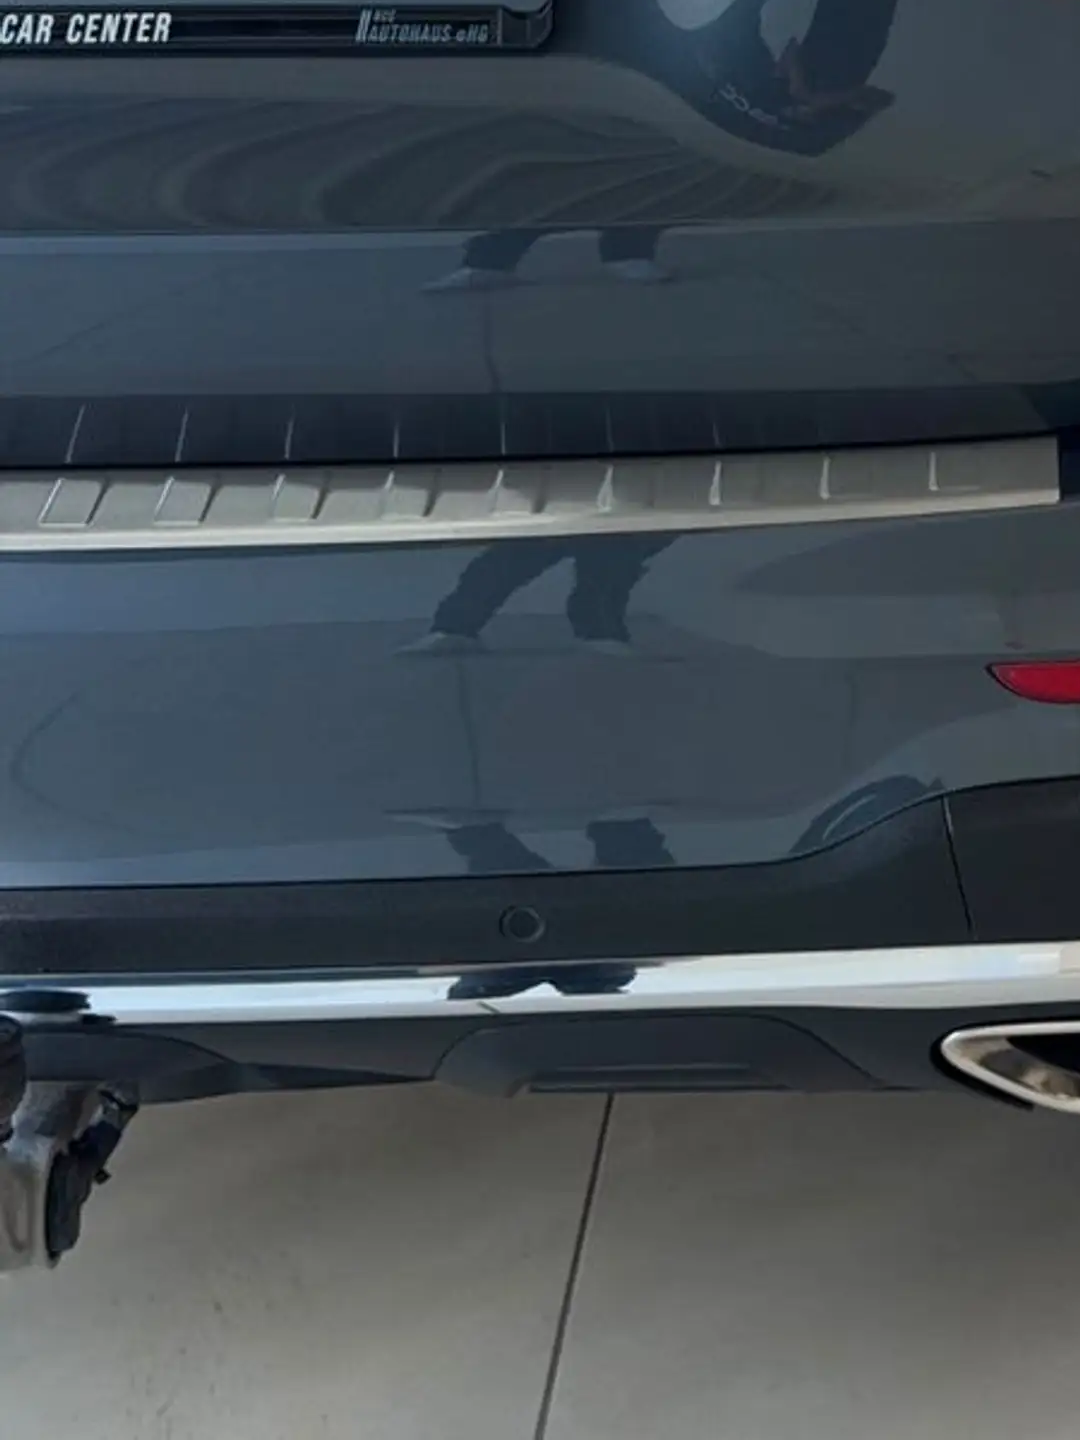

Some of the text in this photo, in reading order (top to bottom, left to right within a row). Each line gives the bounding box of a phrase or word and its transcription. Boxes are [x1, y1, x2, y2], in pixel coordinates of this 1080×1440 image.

[0, 12, 172, 45] CAR CENTER
[368, 23, 453, 43] AUTOHAUS
